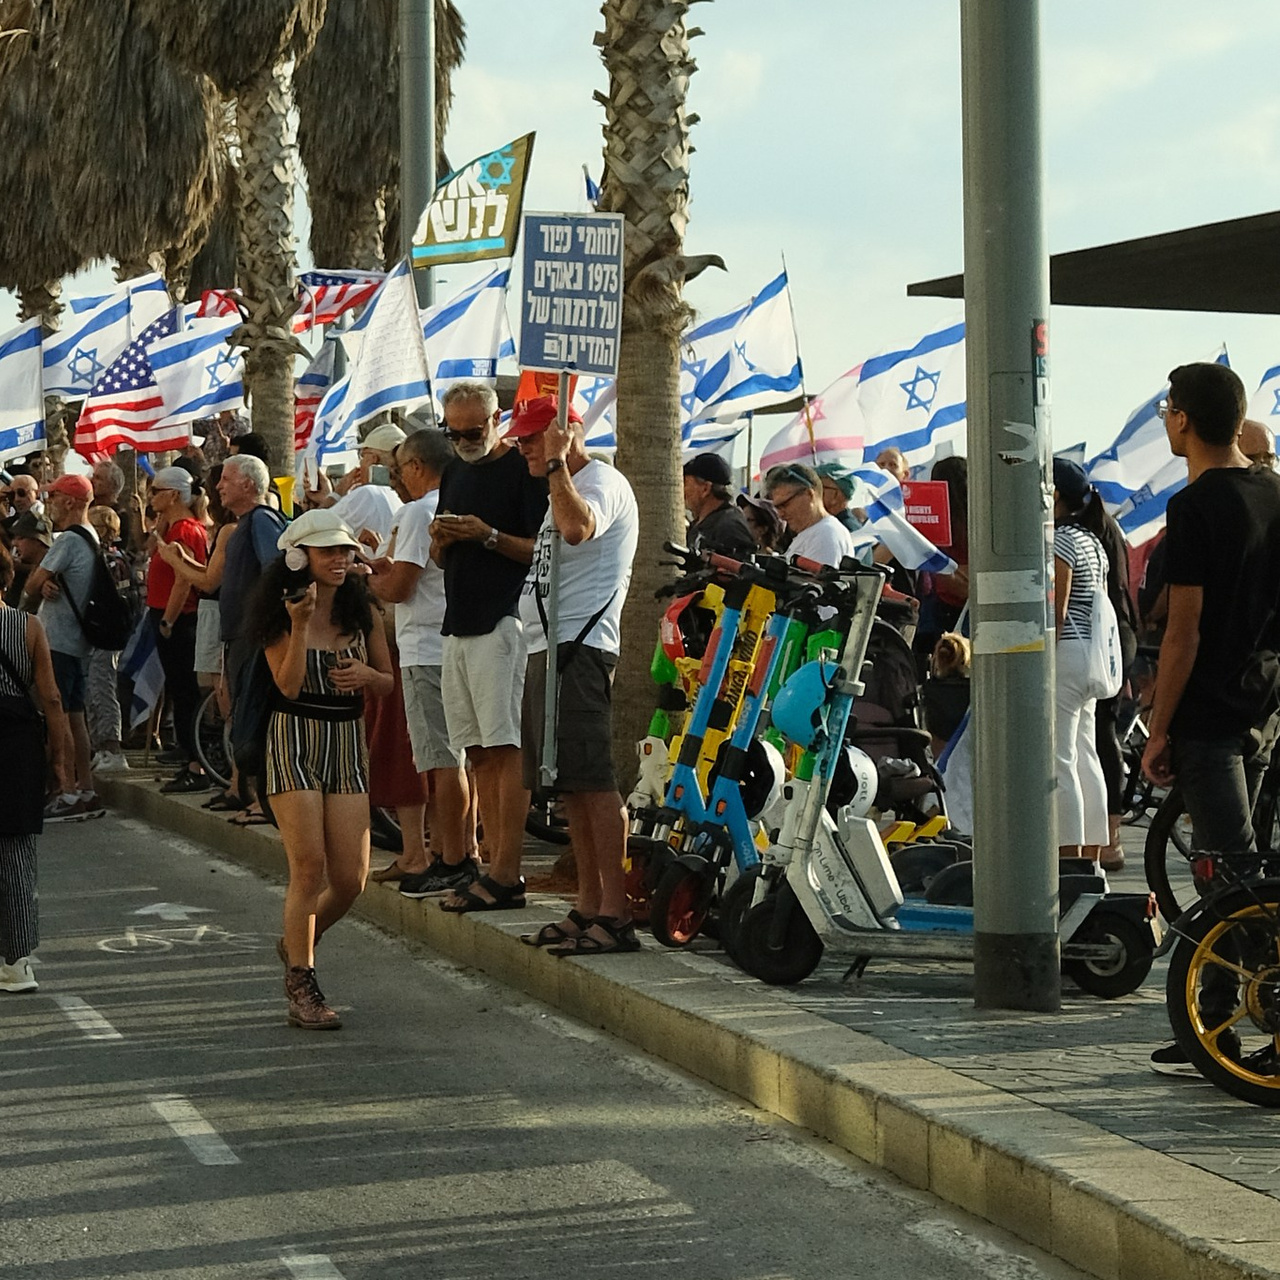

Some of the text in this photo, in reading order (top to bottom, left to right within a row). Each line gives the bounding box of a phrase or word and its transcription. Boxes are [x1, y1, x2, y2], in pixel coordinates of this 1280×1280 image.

[576, 222, 620, 256] לוחמי
[587, 262, 619, 294] 1973
[527, 290, 551, 325] של
[599, 294, 618, 330] על
